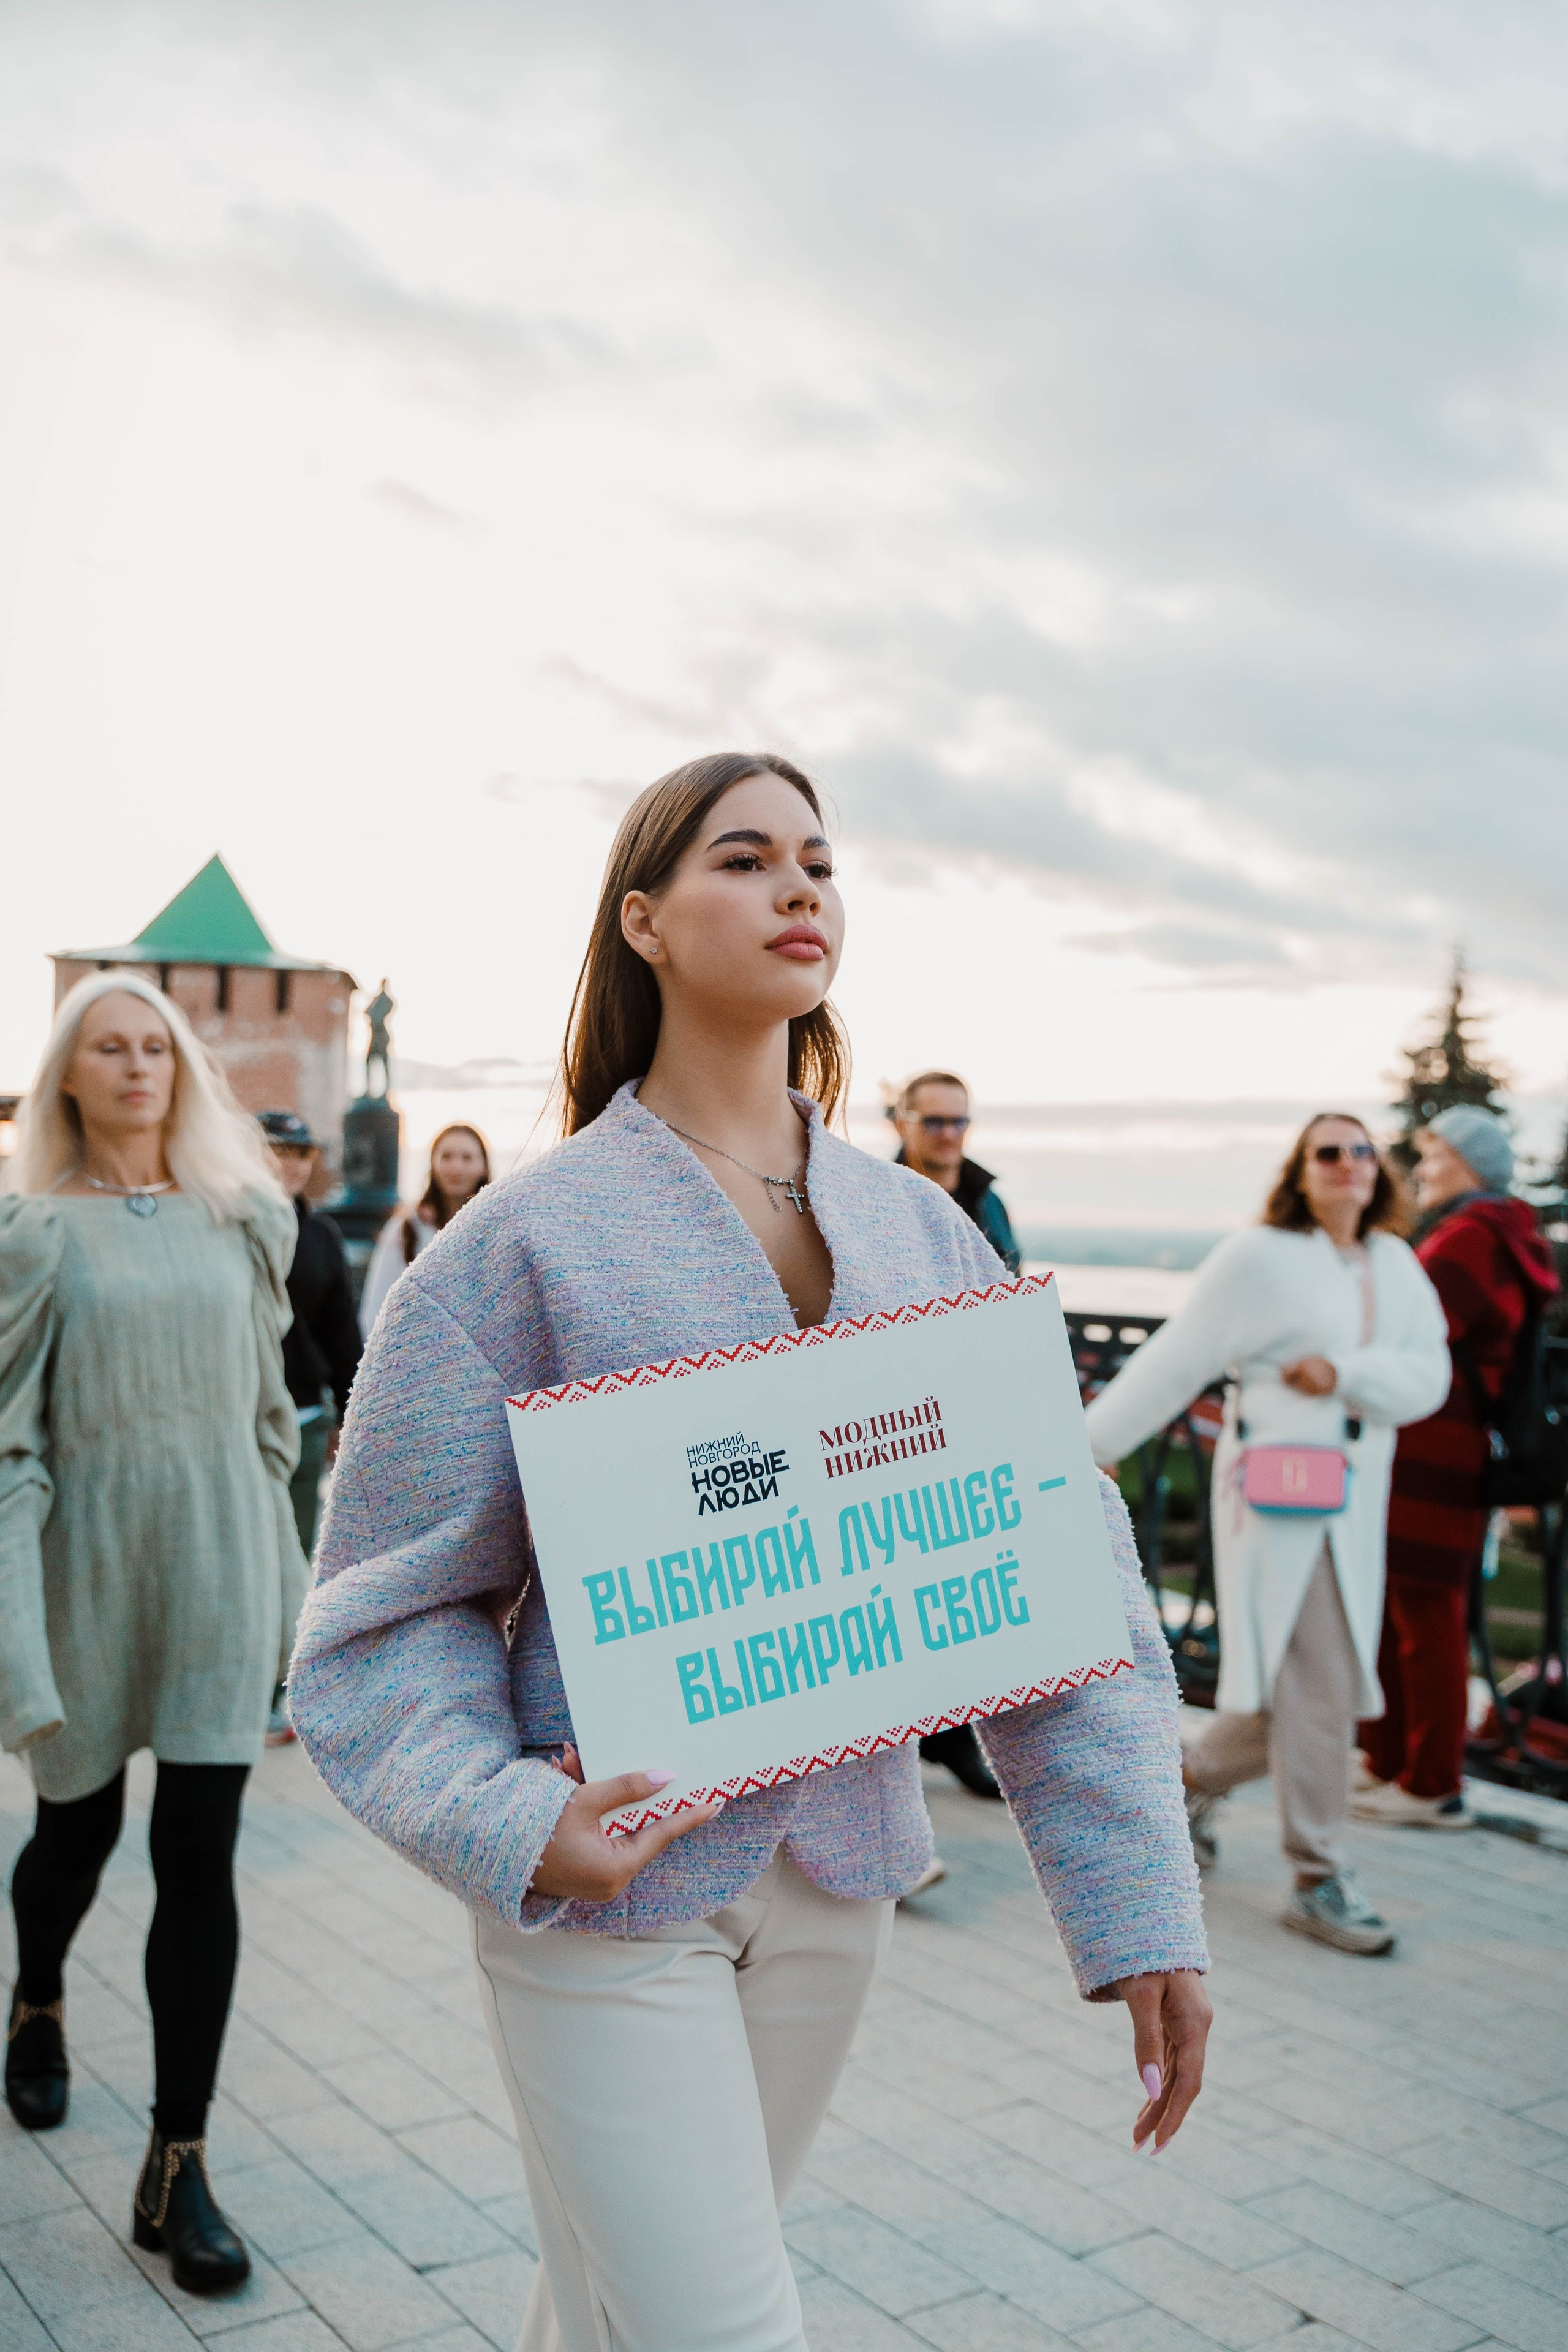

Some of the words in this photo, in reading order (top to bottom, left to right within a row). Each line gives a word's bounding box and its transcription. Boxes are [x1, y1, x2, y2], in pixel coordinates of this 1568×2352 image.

[686, 1431, 745, 1458] НИЖНИЙ
[818, 1396, 943, 1452] МОДНЫЙ
[688, 1441, 761, 1469] НОВГОРОД
[692, 1450, 790, 1494] НОВЫЕ
[824, 1423, 948, 1479] НИЖНИЙ
[698, 1476, 780, 1516] ЛЮДИ
[582, 1505, 821, 1645] ВЫБИРАЙ
[839, 1463, 1022, 1577] ЛУЧШЕЕ
[676, 1583, 903, 1725] ВЫБИРАЙ
[913, 1549, 1031, 1651] СВОЁ
